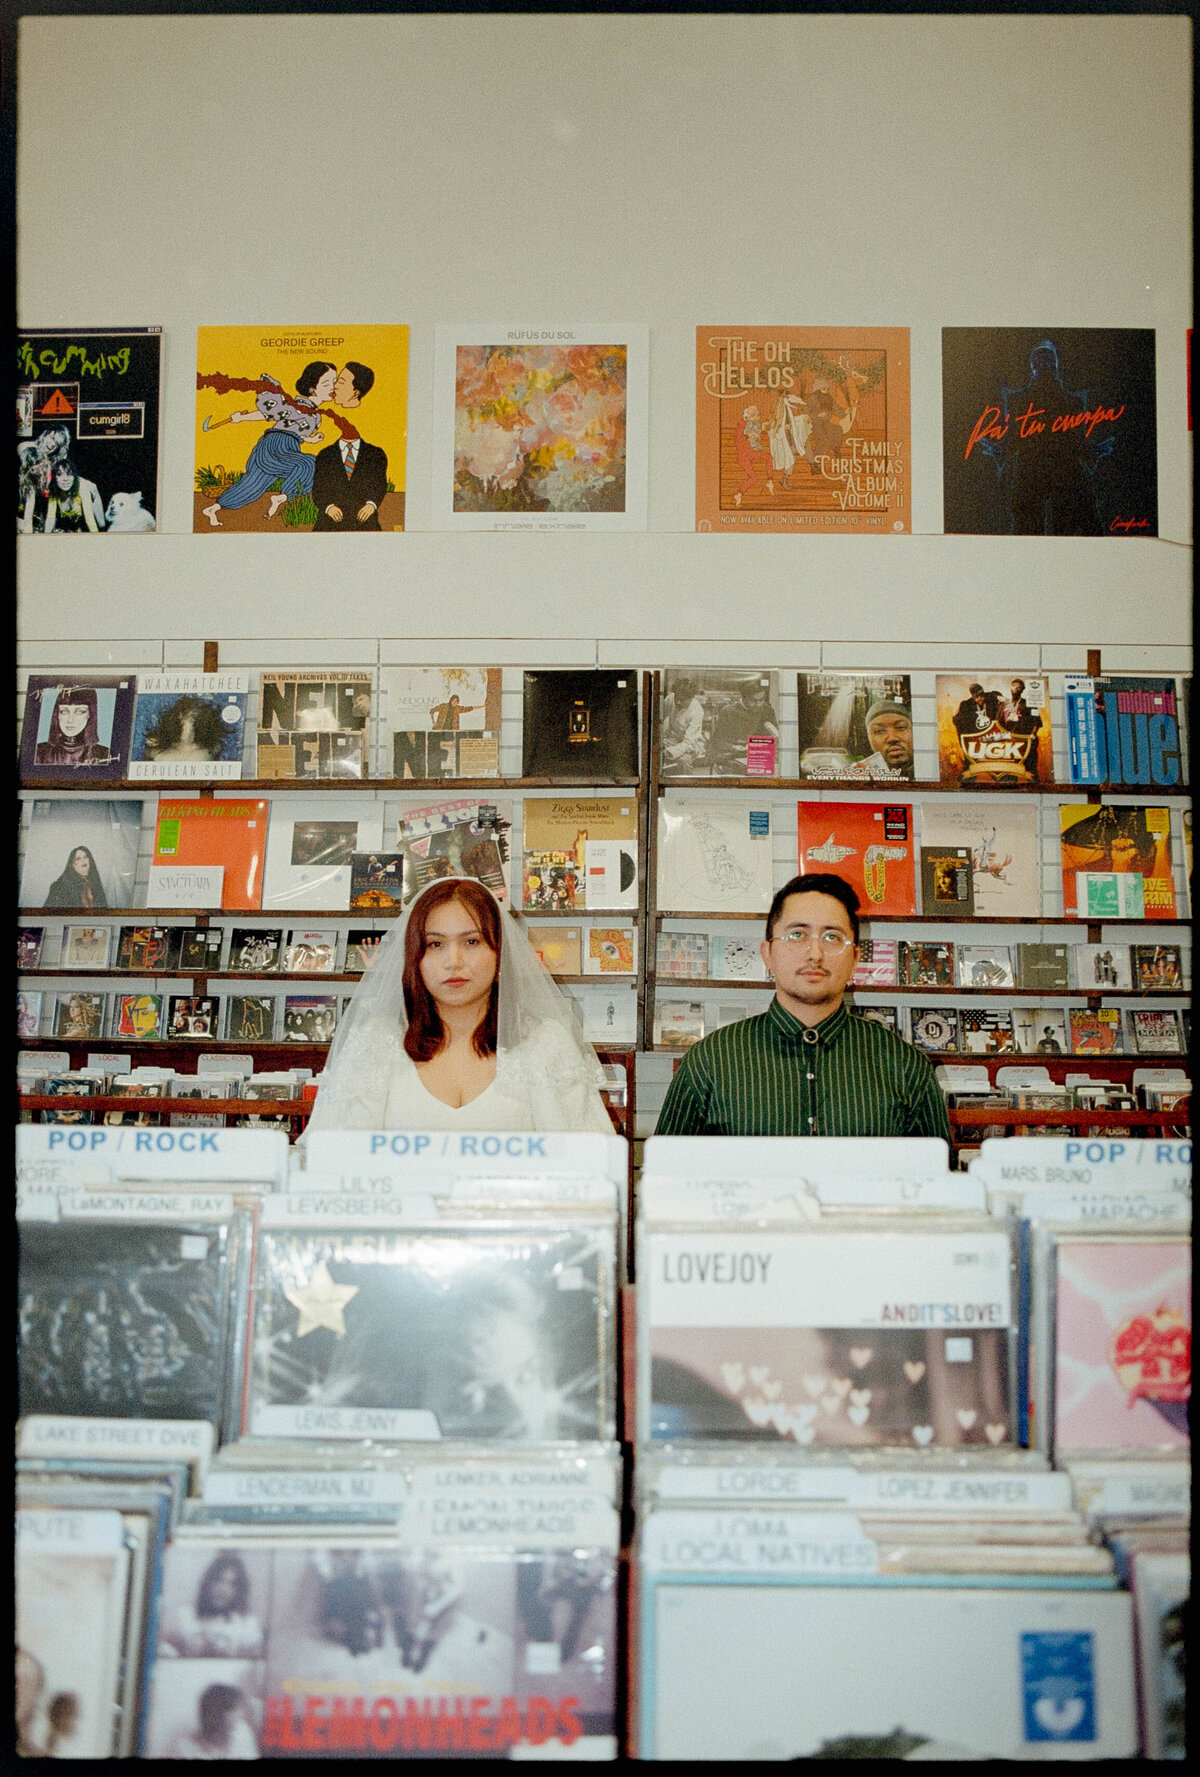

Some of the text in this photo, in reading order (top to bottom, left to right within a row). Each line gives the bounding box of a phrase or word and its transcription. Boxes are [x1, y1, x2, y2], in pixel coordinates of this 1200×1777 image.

[260, 337, 345, 347] GEORDIE GREEP
[541, 331, 555, 340] DU
[557, 331, 576, 340] SOL
[708, 336, 791, 363] THE OH
[701, 365, 795, 398] HELLOS
[89, 412, 131, 426] cumgirl8
[1015, 402, 1046, 438] tu
[846, 438, 903, 462] FAMILY
[814, 455, 904, 480] CHRISTMAS
[841, 474, 904, 497] ALBUM:
[832, 490, 904, 510] VOLUME II
[721, 516, 736, 525] NOW
[740, 516, 774, 525] AVAILABLE
[777, 516, 787, 525] ON
[789, 516, 818, 525] LIMITED
[820, 516, 848, 525] EDITION
[866, 517, 886, 526] VINYL
[144, 677, 242, 691] WAXAHATCHEE
[299, 673, 328, 681] ARCHIVES
[968, 741, 1025, 760] UGK
[136, 764, 233, 777] CERULEAN SALT
[158, 806, 251, 817] TALKING HEADS
[404, 811, 427, 820] THE
[432, 803, 463, 815] BEST
[159, 877, 211, 890] SANCTUARY
[929, 1023, 940, 1038] DJ
[49, 1131, 107, 1151] POP
[135, 1132, 220, 1152] ROCK
[371, 1135, 431, 1156] POP
[460, 1136, 548, 1157] ROCK
[1065, 1142, 1126, 1164] POP
[340, 1176, 394, 1193] LILYS
[1045, 1167, 1093, 1185] BRUNO
[191, 1197, 225, 1211] RAY
[286, 1197, 403, 1215] LEWSBERG
[662, 1252, 773, 1284] LOVEJOY
[349, 1410, 398, 1431] JENNY
[36, 1426, 200, 1445] LAKE STREET DIVE
[350, 1478, 375, 1499] MJ
[510, 1471, 590, 1487] ADRIANNE
[715, 1472, 799, 1493] LORDE
[944, 1479, 1029, 1501] JENNIFER
[432, 1516, 576, 1535] LEMONHEADS
[663, 1539, 876, 1566] LOCAL NATIVES
[279, 1695, 584, 1749] LEMONHEADS
